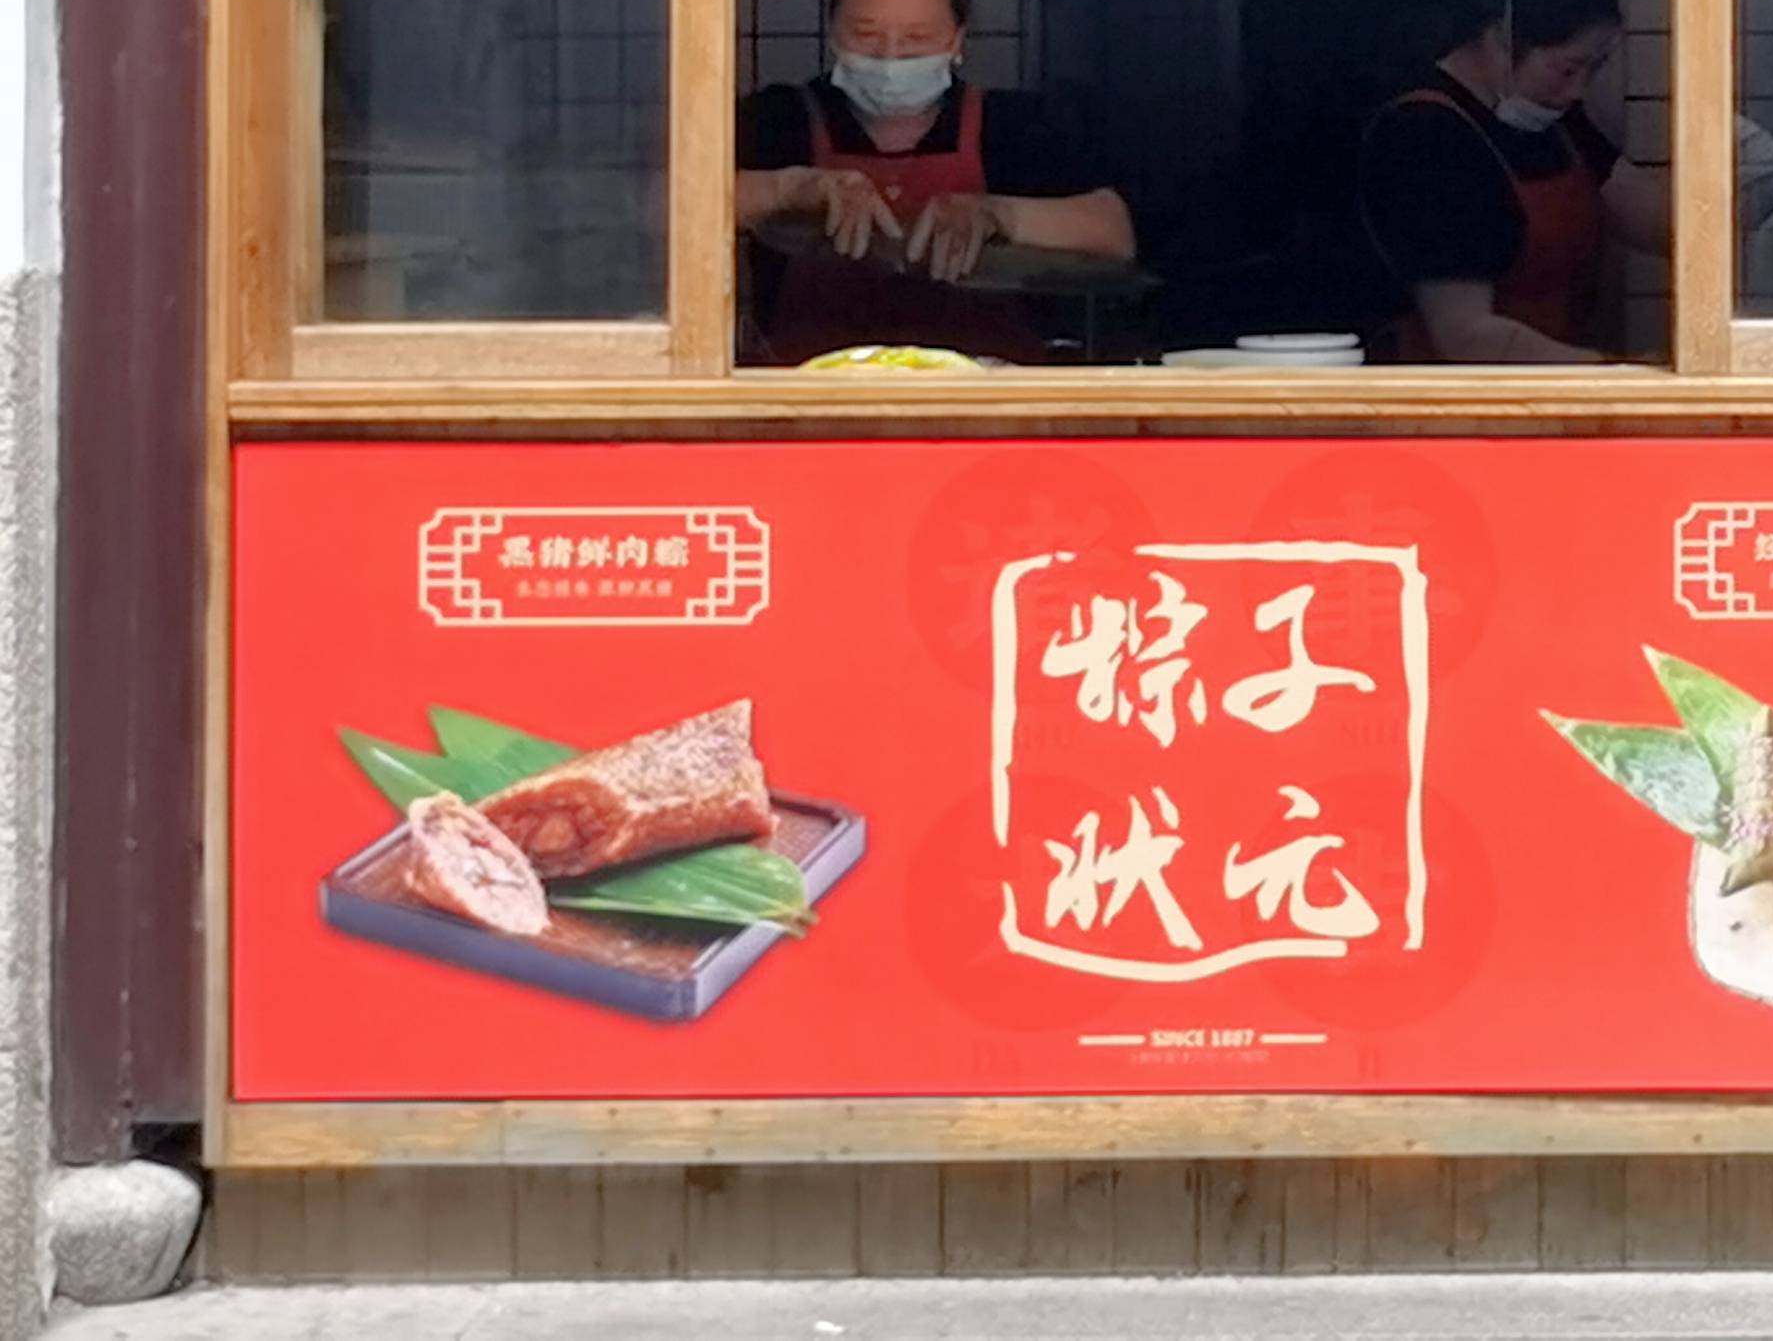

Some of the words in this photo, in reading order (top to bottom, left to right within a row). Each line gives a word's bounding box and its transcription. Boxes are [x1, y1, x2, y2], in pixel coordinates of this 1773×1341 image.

[1040, 570, 1377, 748] 粽子
[1043, 784, 1381, 950] 状元
[1150, 1029, 1205, 1048] SINCE
